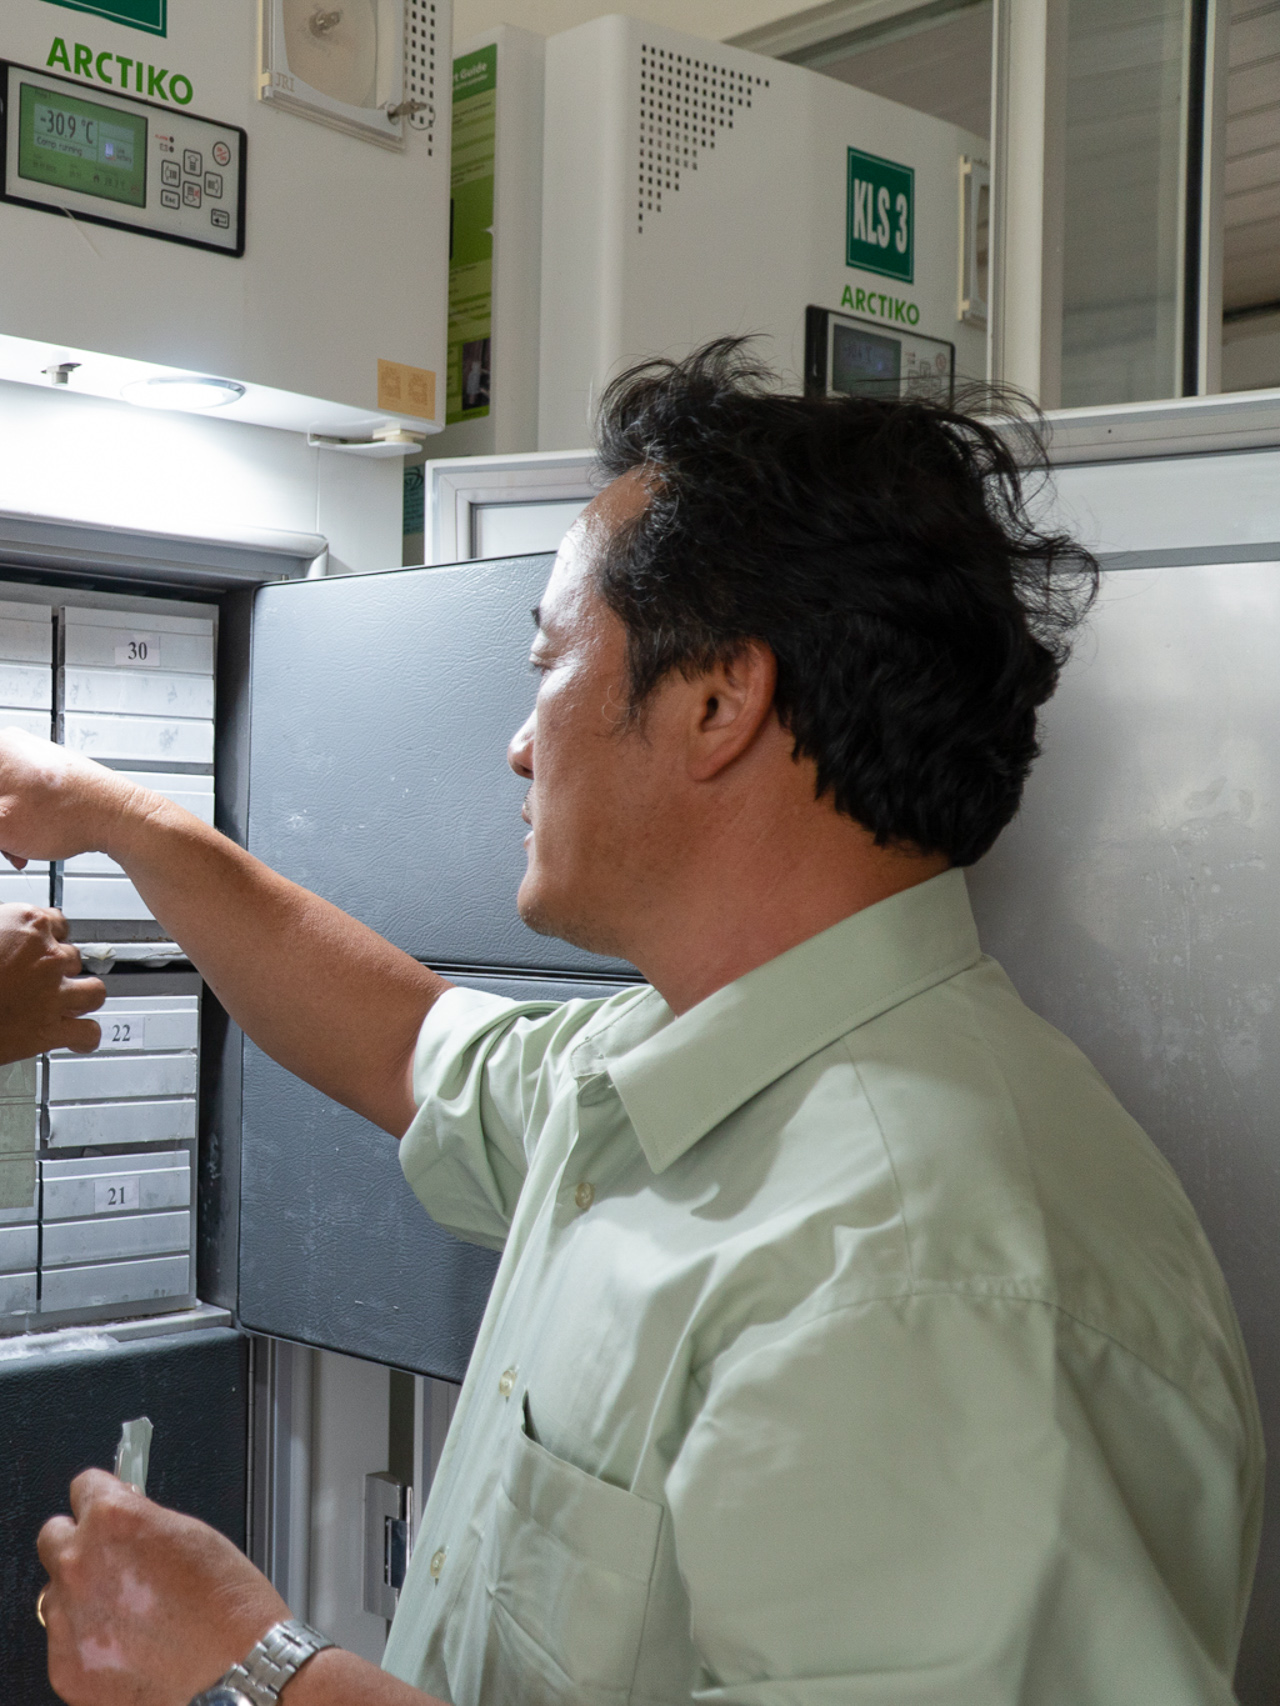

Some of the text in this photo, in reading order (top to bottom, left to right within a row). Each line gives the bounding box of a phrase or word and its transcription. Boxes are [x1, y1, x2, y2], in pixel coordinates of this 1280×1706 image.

[46, 37, 194, 105] ARCTIKO
[276, 73, 295, 93] JRI
[41, 110, 76, 138] -30.9
[853, 178, 908, 254] KLS 3
[841, 284, 920, 325] ARCTIKO
[128, 641, 148, 661] 30
[112, 1024, 131, 1041] 22
[107, 1186, 125, 1205] 21
